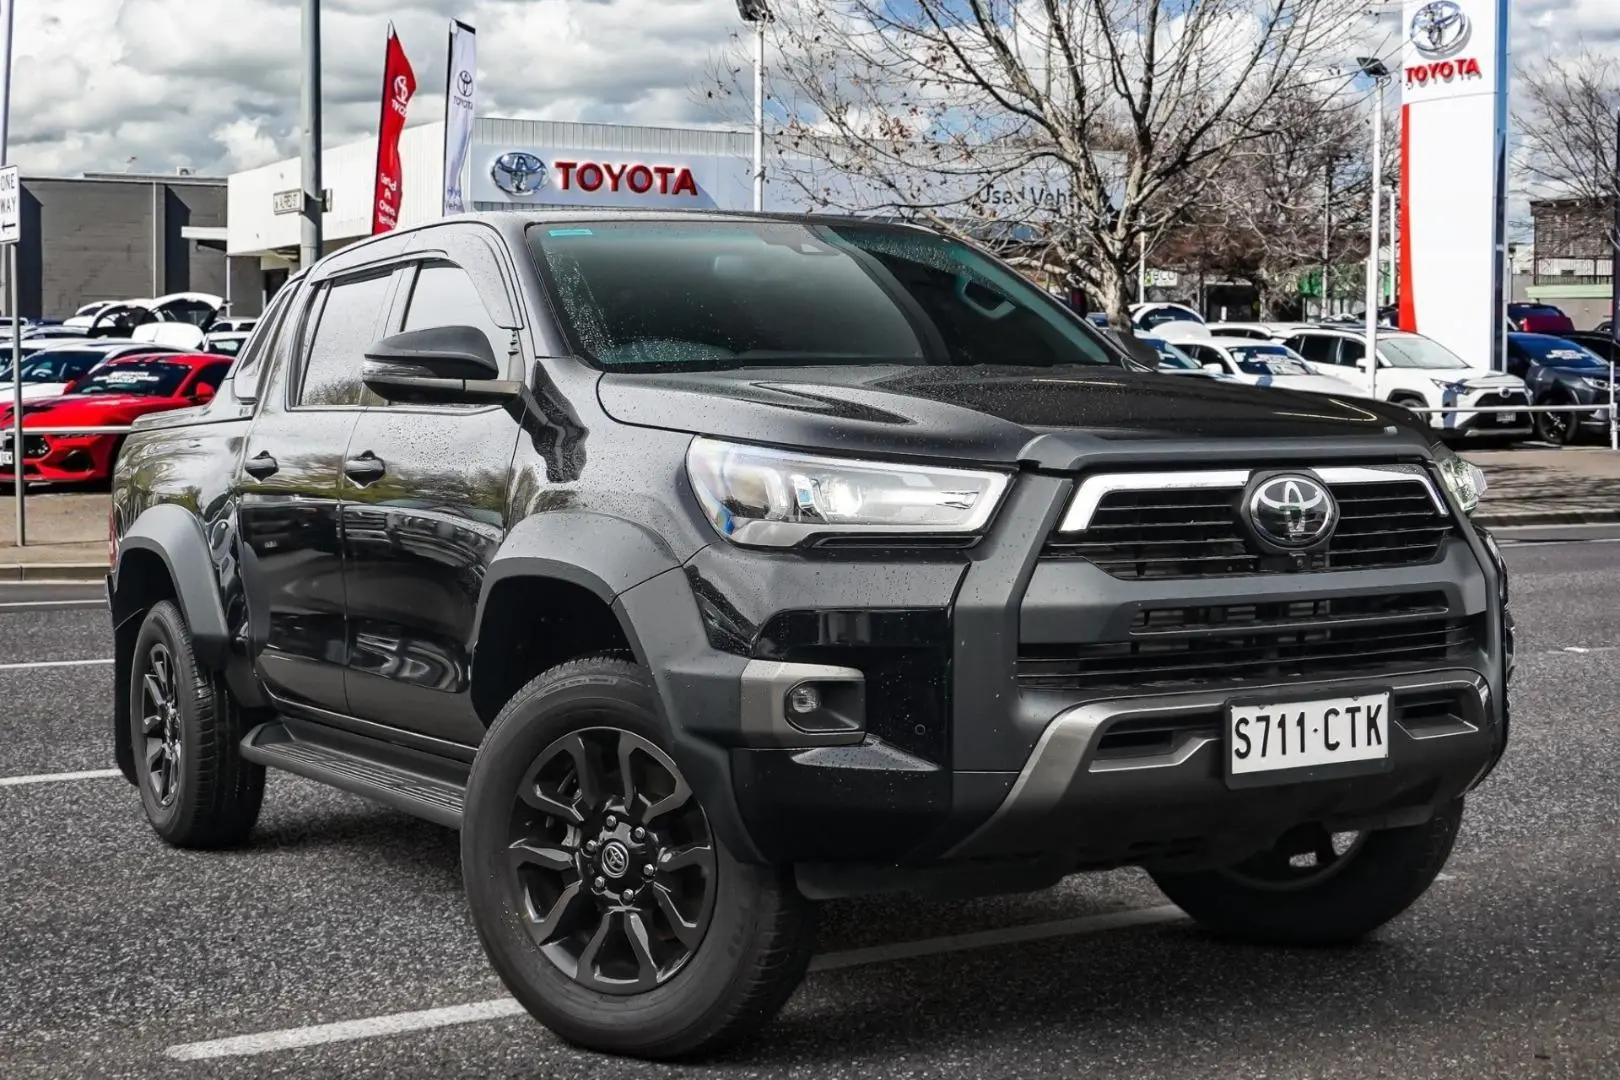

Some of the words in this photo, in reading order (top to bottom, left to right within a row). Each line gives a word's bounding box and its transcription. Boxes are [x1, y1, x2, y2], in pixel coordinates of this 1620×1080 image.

[1404, 58, 1480, 83] TOYOTA
[555, 161, 698, 196] TOYOTA
[0, 195, 17, 214] WAY
